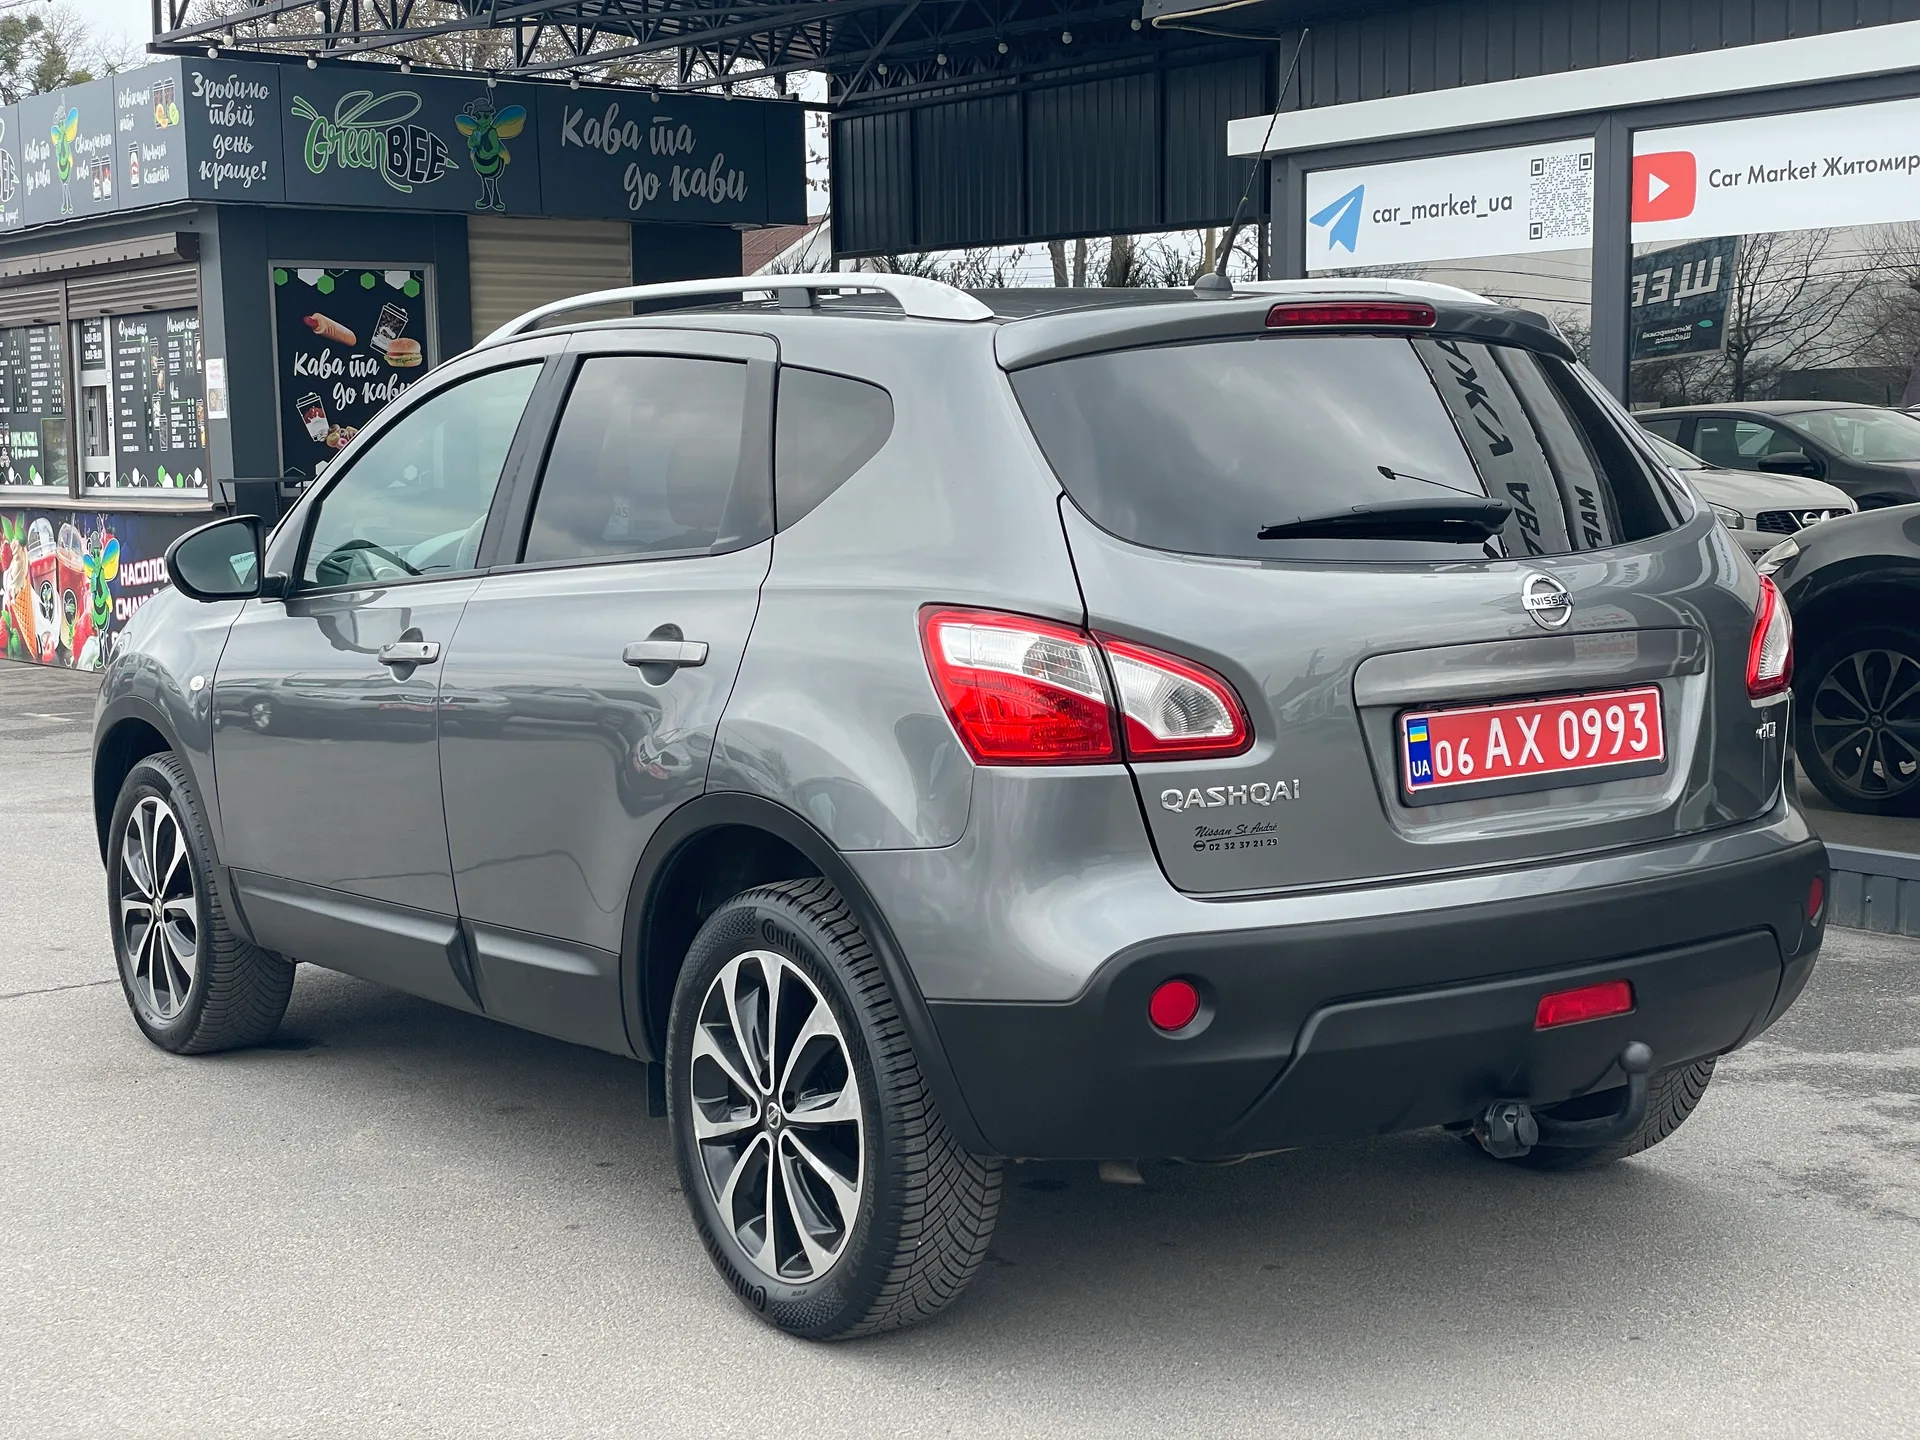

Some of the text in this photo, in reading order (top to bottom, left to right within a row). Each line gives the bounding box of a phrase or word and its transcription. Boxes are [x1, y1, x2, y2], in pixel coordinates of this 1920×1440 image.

[191, 71, 270, 106] Зробимо
[209, 100, 254, 127] твій
[562, 103, 696, 156] Кава та
[213, 133, 254, 160] день
[199, 160, 268, 190] краще!
[623, 152, 749, 211] до кави
[1708, 168, 1742, 190] Car
[1747, 160, 1817, 187] Market
[1372, 192, 1513, 228] car_market_ua
[294, 348, 380, 380] Кава та
[332, 382, 357, 411] до
[1435, 702, 1648, 777] 06 AX 0993
[1412, 760, 1431, 777] UA
[1160, 778, 1300, 813] QASHQAI
[1194, 825, 1232, 838] Nissan
[1235, 823, 1248, 835] St
[1209, 838, 1278, 851] 02 32 37 21 29
